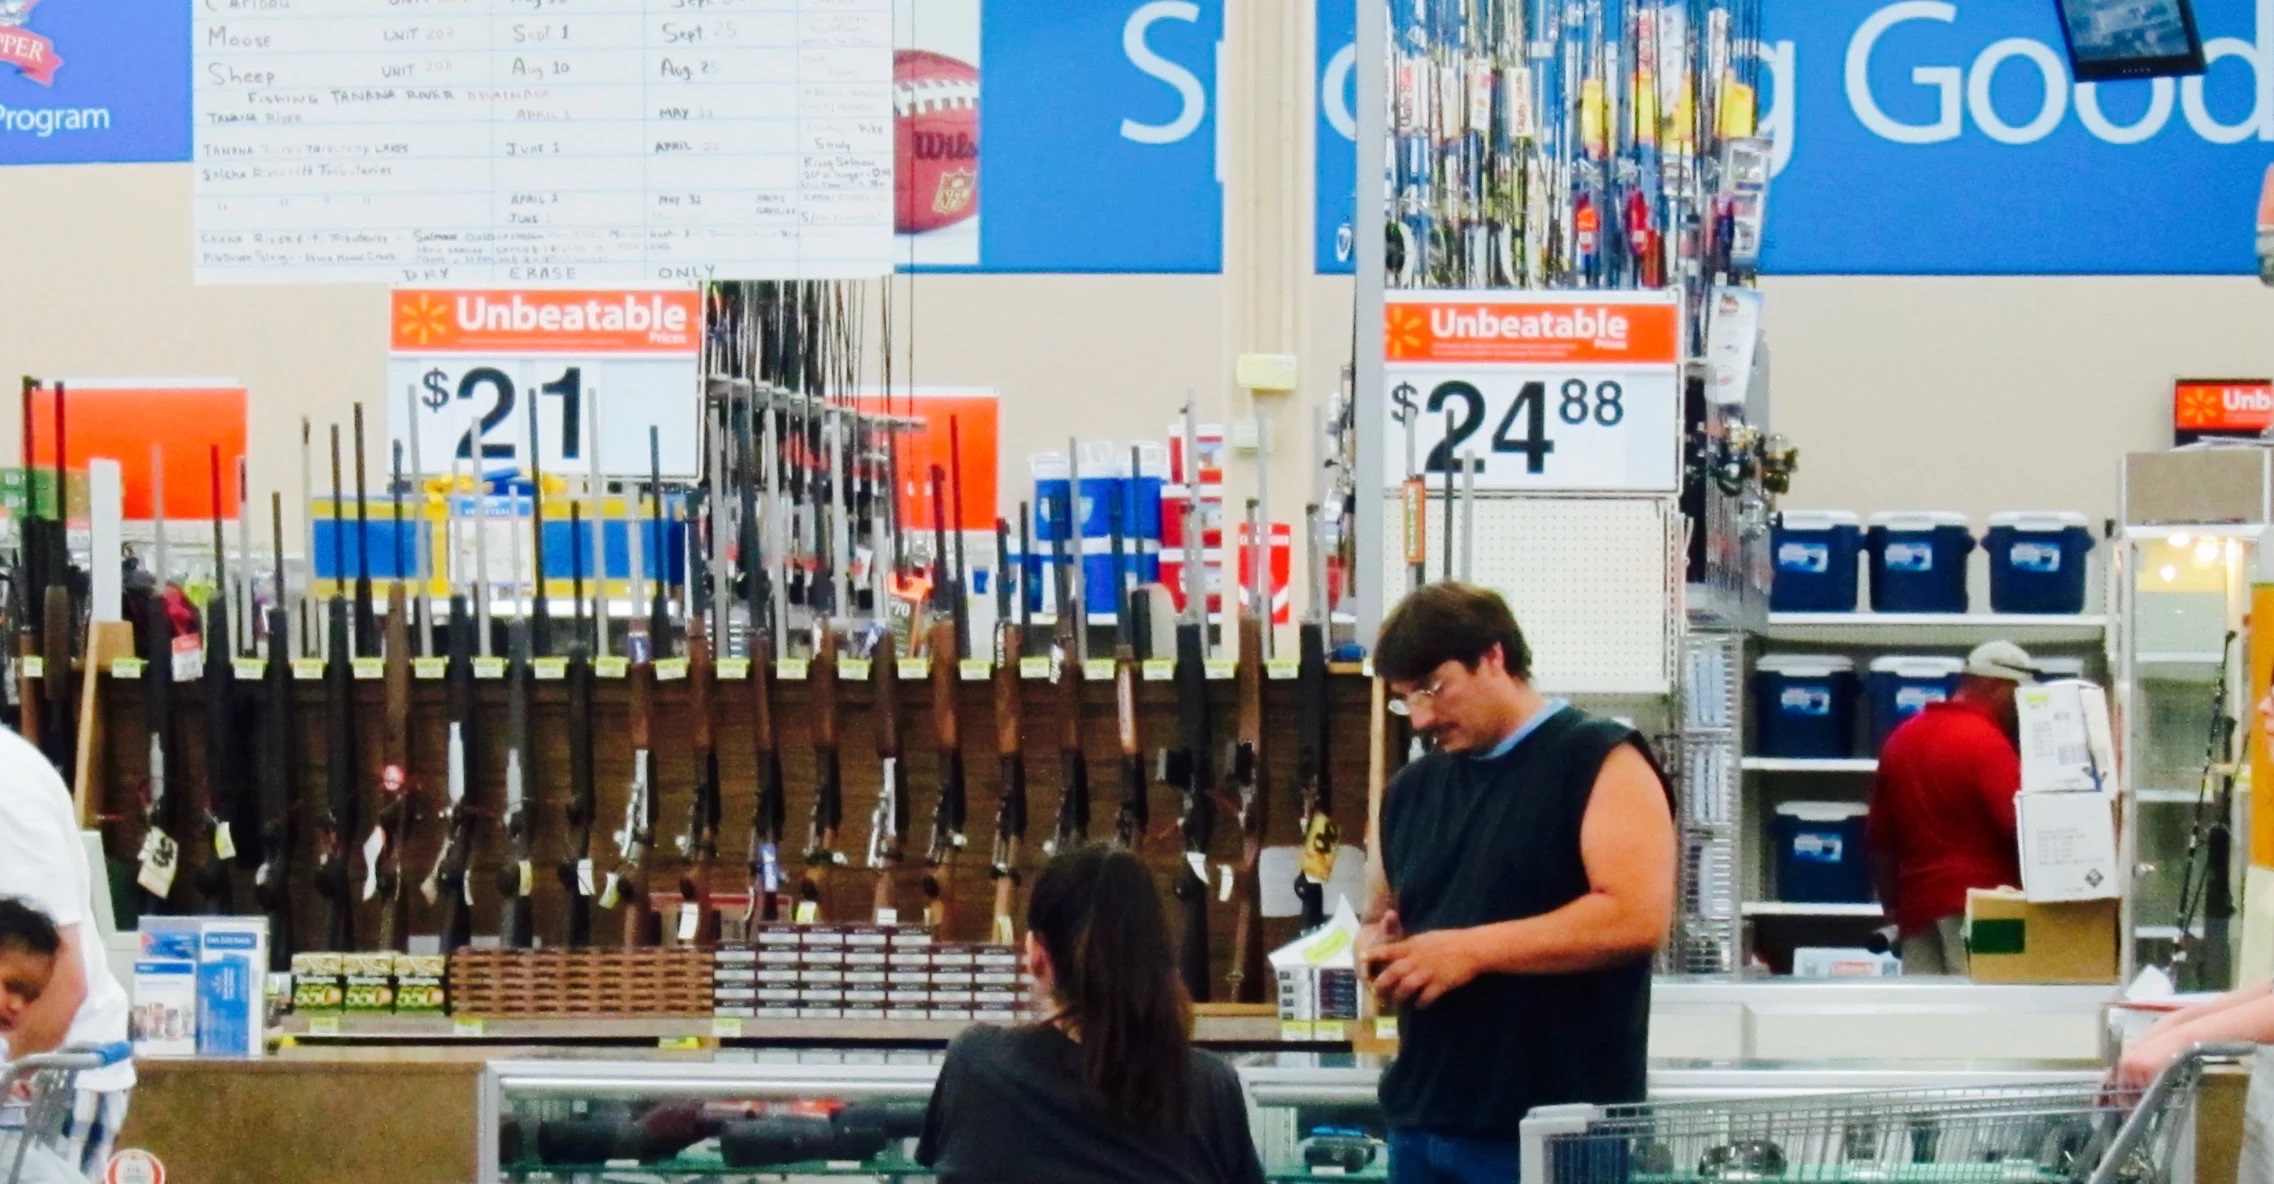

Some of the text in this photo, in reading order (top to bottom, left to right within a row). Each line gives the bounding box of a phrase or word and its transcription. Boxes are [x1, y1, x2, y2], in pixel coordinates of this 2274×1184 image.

[208, 26, 272, 48] Moose
[383, 27, 418, 42] UNIT
[208, 62, 275, 86] Sheep
[382, 64, 415, 78] UNIT
[512, 56, 543, 80] Aug
[552, 60, 570, 74] 10
[406, 90, 454, 101] RIVER
[659, 107, 689, 120] MAY
[505, 142, 544, 156] JUNE
[655, 142, 692, 153] APRIL
[511, 194, 545, 205] APRIL
[510, 267, 577, 281] ERASE
[658, 264, 714, 280] ONLY
[457, 296, 688, 331] Unbeatable
[1431, 307, 1628, 339] Unbeatable
